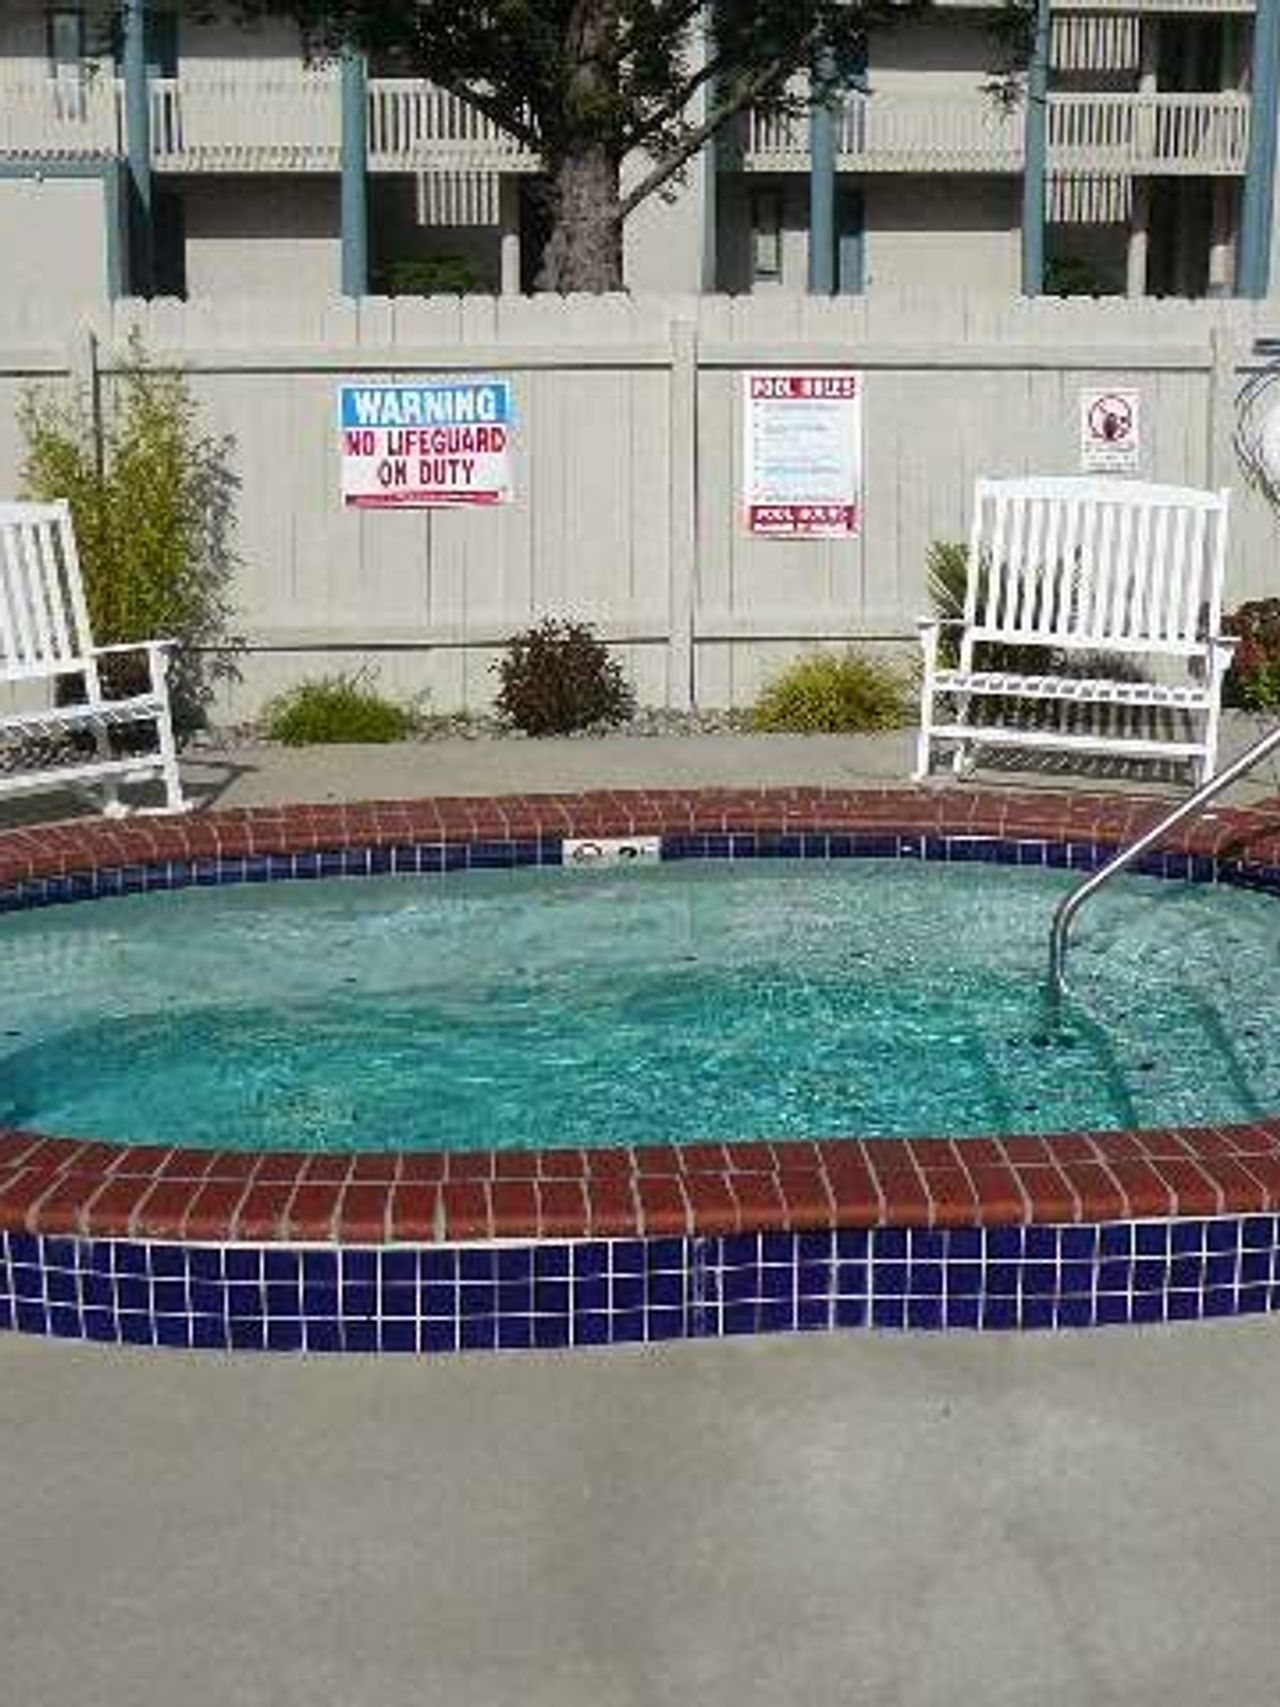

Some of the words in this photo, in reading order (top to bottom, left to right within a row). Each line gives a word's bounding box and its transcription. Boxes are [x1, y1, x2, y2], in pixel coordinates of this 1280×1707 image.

[753, 377, 794, 398] POOL
[354, 387, 497, 425] WARNING
[347, 430, 375, 456] NO
[387, 426, 507, 456] LIFEGUARD
[377, 459, 407, 486] ON
[419, 458, 475, 485] DUTY
